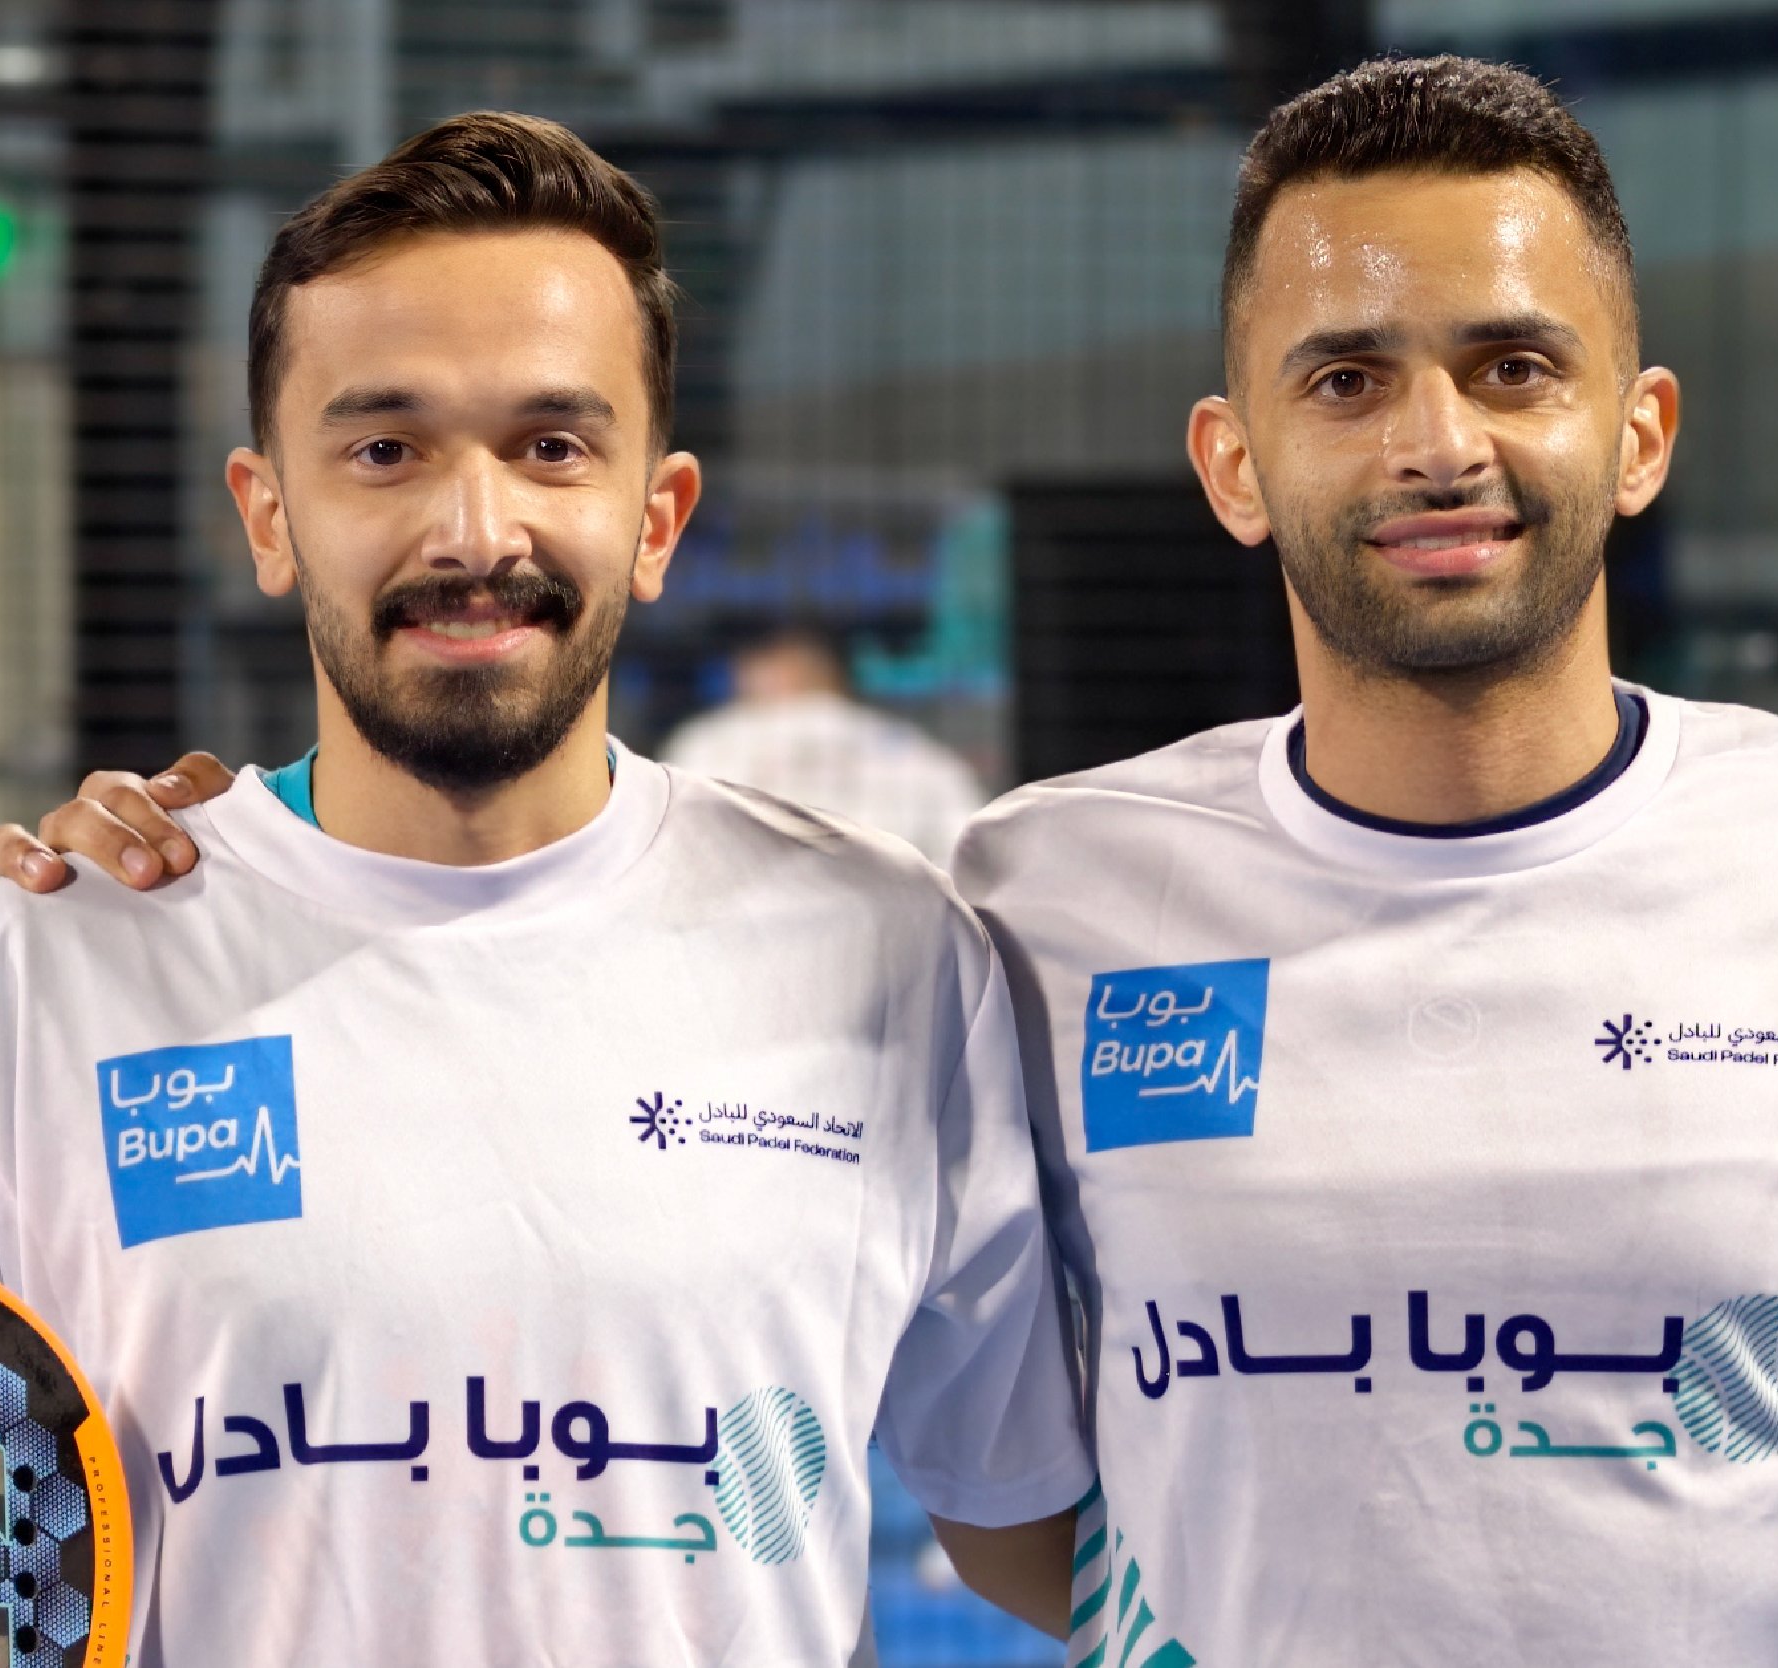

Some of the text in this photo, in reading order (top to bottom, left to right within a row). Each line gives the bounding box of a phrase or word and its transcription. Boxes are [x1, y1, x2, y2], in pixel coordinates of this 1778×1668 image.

[1097, 985, 1213, 1029] بوبا
[1669, 1022, 1721, 1043] للبادل
[1091, 1039, 1206, 1077] Bupa
[1668, 1049, 1718, 1061] Saudi
[1721, 1049, 1769, 1064] Padel
[111, 1064, 234, 1117] بوبا
[699, 1101, 747, 1123] للبادل
[118, 1118, 238, 1168] Bupa
[754, 1110, 819, 1131] السعودي
[699, 1128, 860, 1164] Saudi Padel Federation
[1131, 1290, 1684, 1399] بوبا بادل
[158, 1377, 718, 1504] بوبا بادل
[1463, 1403, 1677, 1471] جدة
[519, 1492, 718, 1563] جدة
[89, 1457, 112, 1665] PROFESSIONAL LINE
